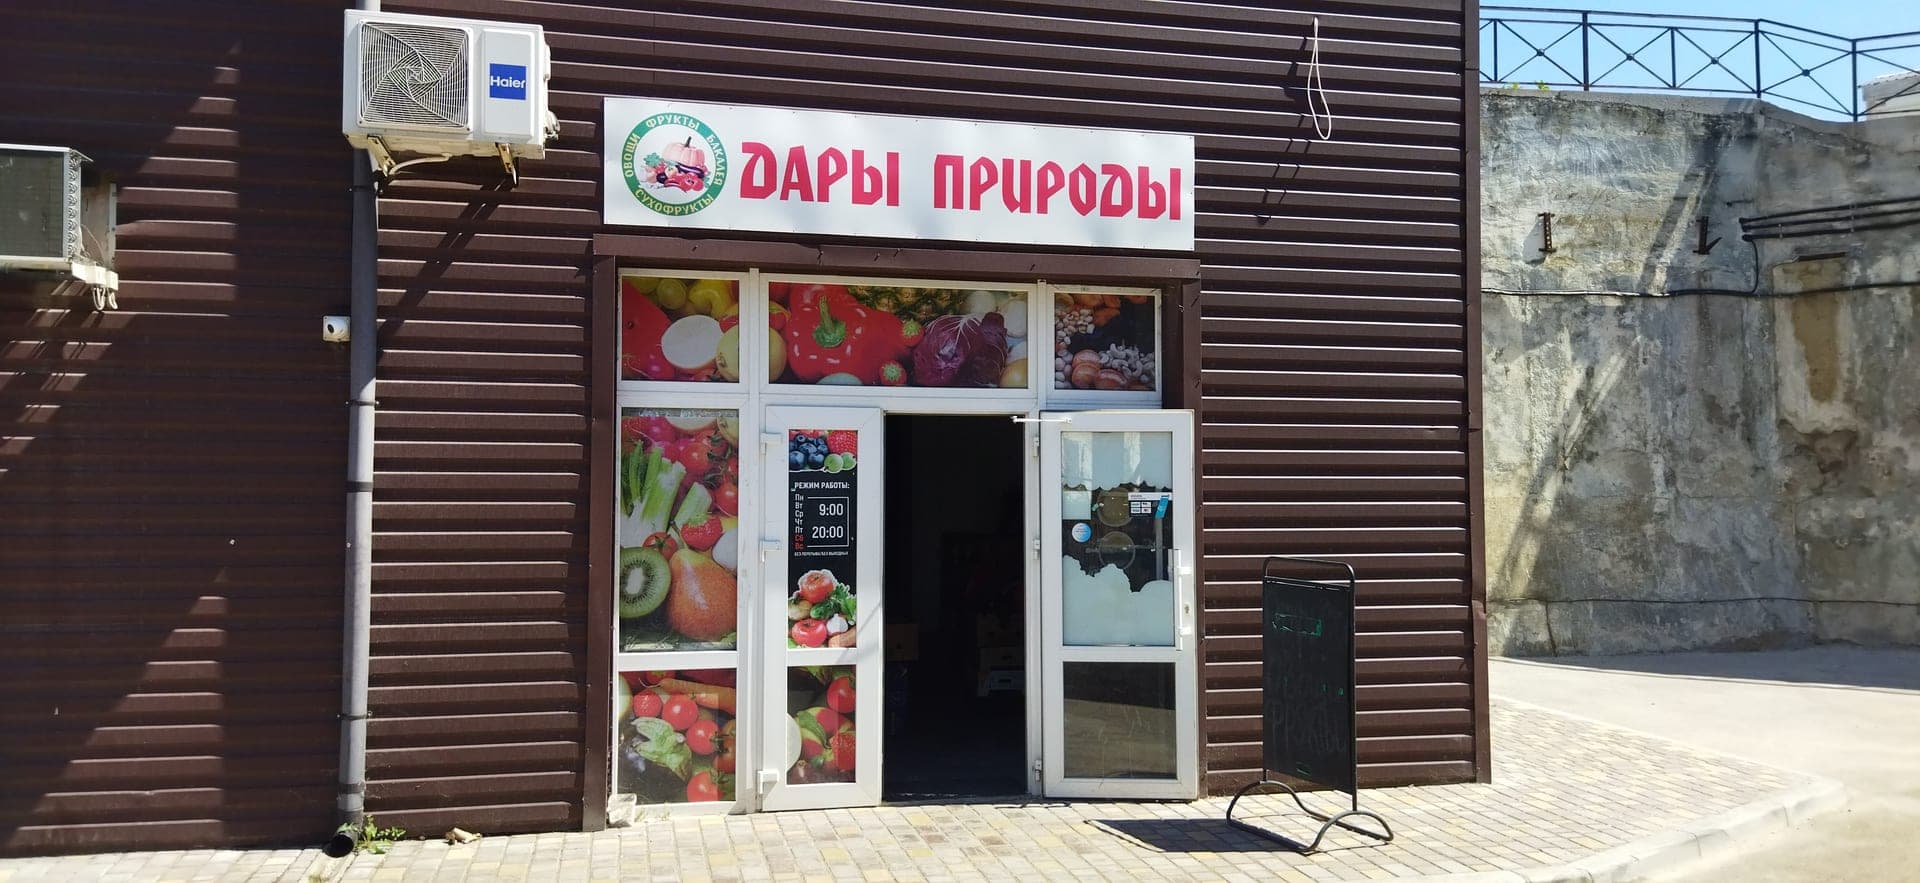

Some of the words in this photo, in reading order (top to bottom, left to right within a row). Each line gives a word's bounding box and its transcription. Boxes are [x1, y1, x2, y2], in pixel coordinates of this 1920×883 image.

[490, 75, 526, 89] Haier
[645, 114, 700, 130] ФРУКТЫ
[706, 133, 725, 186] БАКАЛЕЯ
[739, 141, 900, 207] ДАРЫ
[933, 154, 1182, 221] ПРИРОДЫ
[634, 188, 714, 215] СУХОФРУКТЫ
[794, 481, 820, 489] РЕЖИМ
[795, 493, 804, 501] Пн
[795, 510, 804, 519] Ср
[819, 503, 844, 516] 9:00
[812, 526, 844, 539] 20:00
